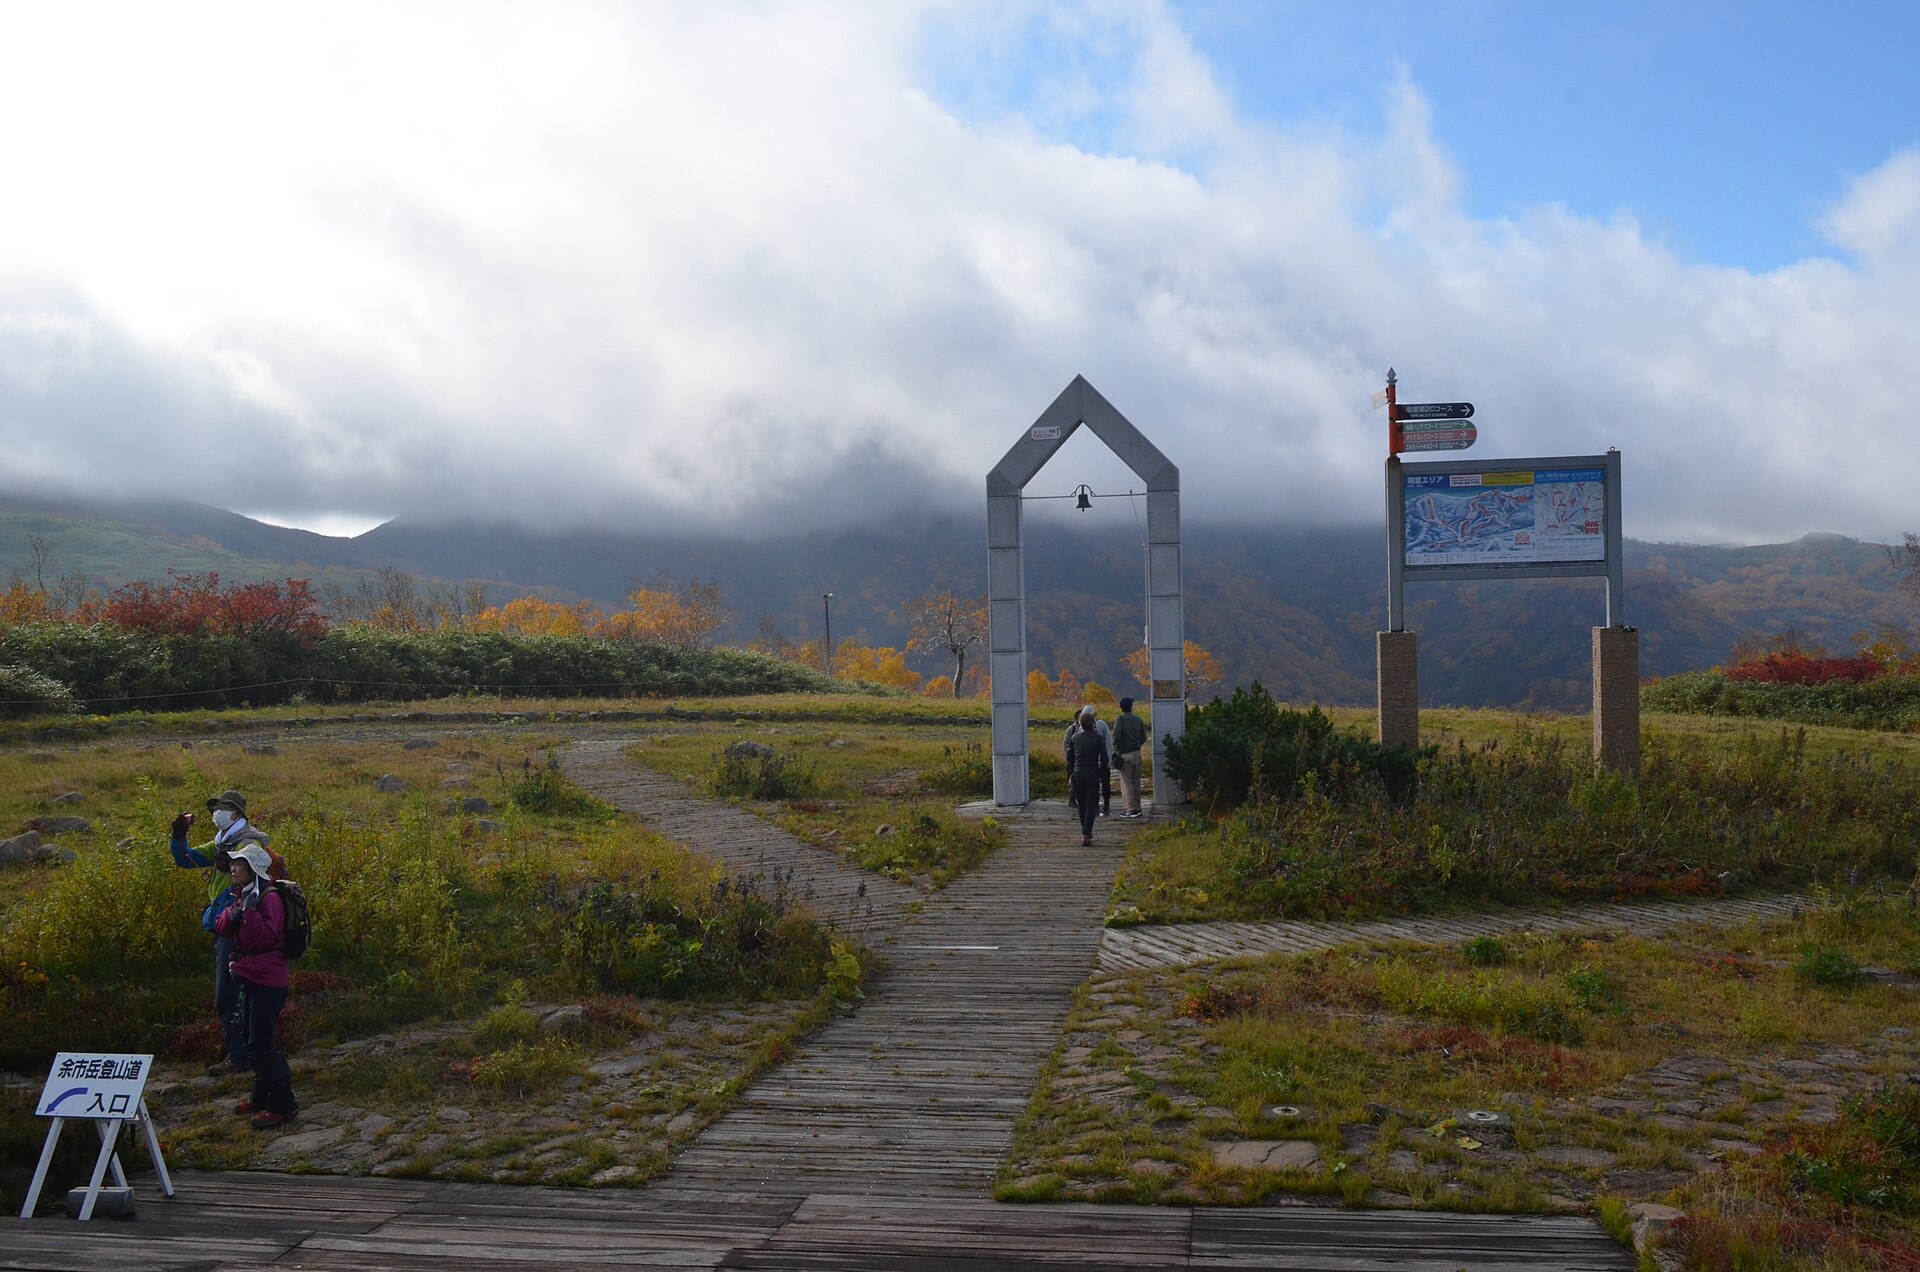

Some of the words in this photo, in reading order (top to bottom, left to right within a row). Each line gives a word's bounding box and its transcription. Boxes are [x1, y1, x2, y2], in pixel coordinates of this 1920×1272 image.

[57, 1058, 142, 1080] 余市岳登山道
[86, 1092, 131, 1114] 入口
